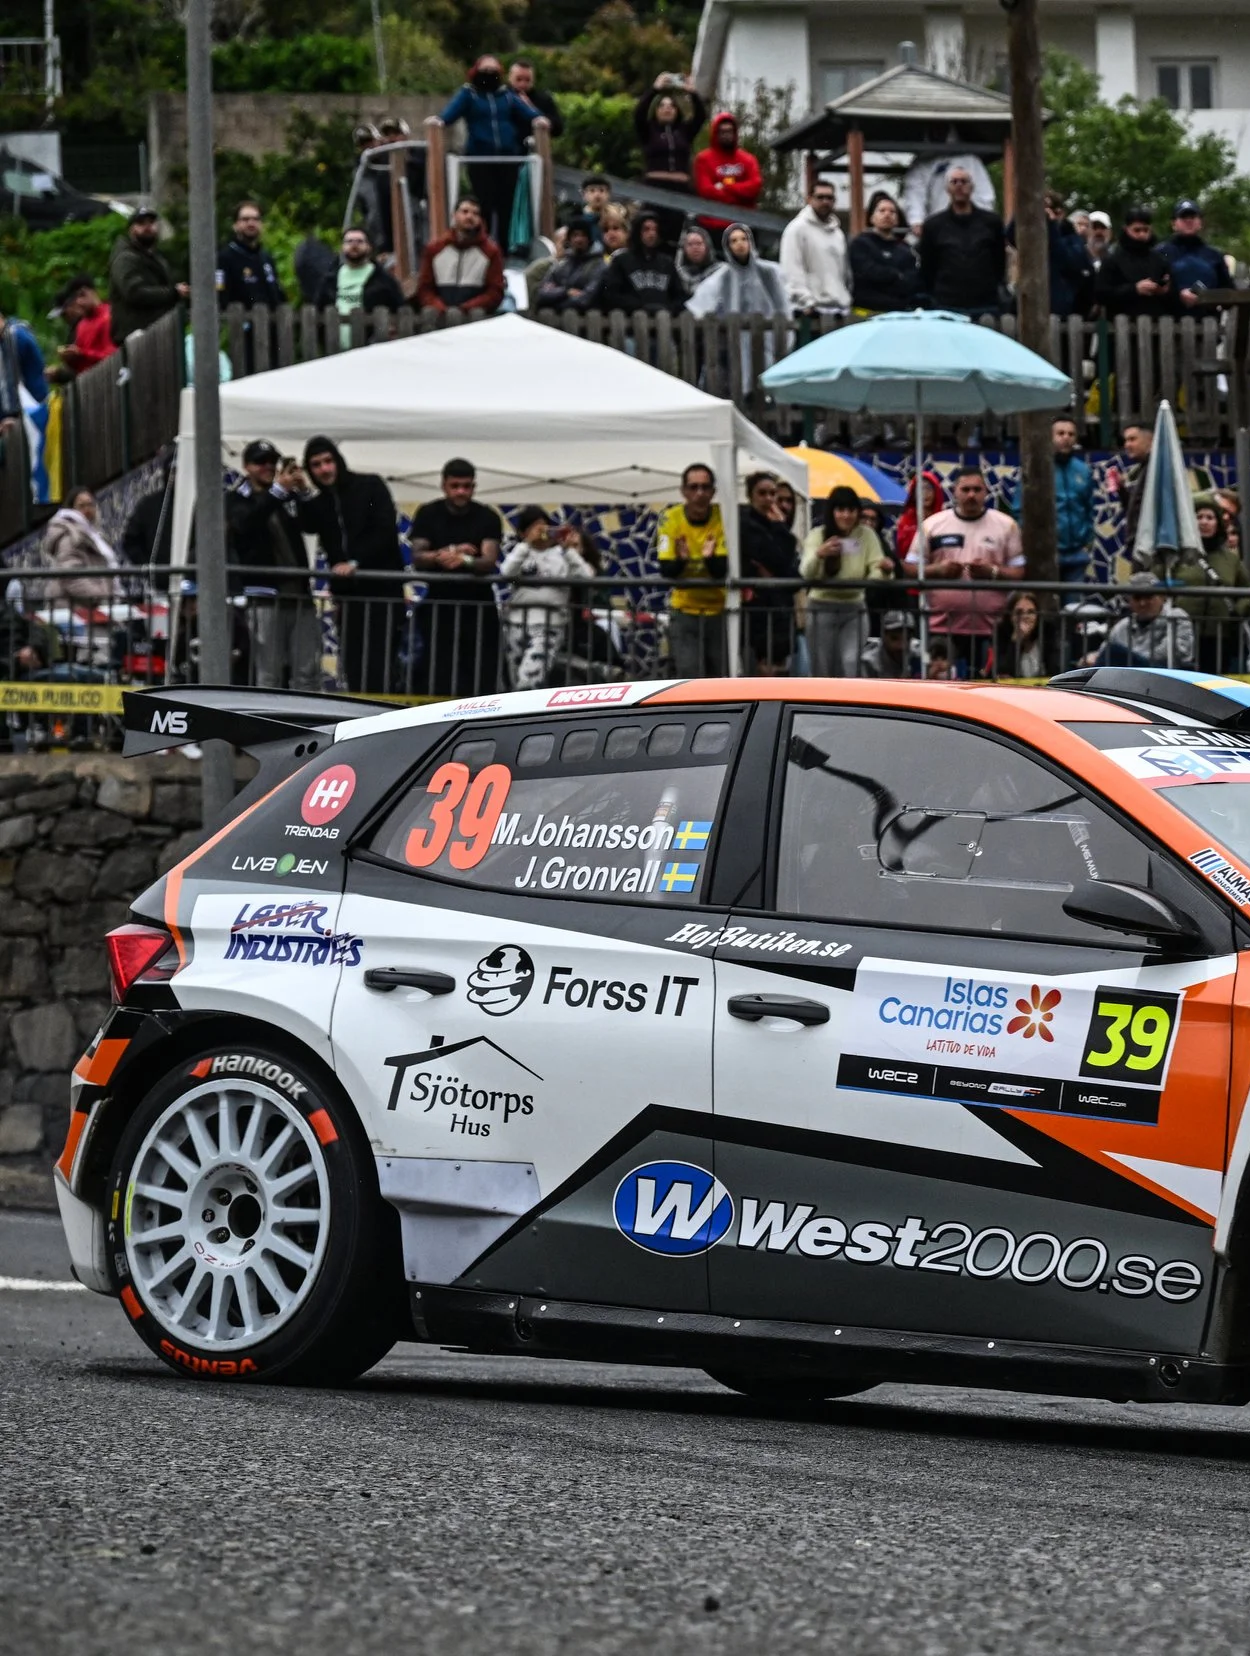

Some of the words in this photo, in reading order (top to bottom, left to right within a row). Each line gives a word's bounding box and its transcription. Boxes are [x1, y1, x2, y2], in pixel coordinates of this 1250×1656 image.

[2, 687, 38, 706] ZONA
[43, 688, 101, 707] PUBLICO
[442, 705, 503, 718] MOTORSPORT
[453, 698, 502, 712] MILLE
[552, 686, 626, 705] MOTUL
[150, 711, 189, 735] MS
[284, 825, 340, 840] TRENDAB
[405, 762, 512, 871] 39
[491, 812, 675, 851] M.Johansson
[515, 856, 662, 893] J.Gronvall
[1211, 874, 1246, 906] MANAGEMENT
[232, 902, 328, 935] LASER
[223, 933, 364, 967] INDUSTRIES
[664, 922, 853, 958] HojButiken.se
[543, 966, 648, 1013] Forss
[654, 975, 700, 1016] IT
[944, 976, 1009, 1009] Islas
[878, 996, 1003, 1036] Canarias
[926, 1039, 962, 1055] LATITUD
[963, 1044, 976, 1056] DE
[977, 1044, 997, 1058] VIDA
[1086, 1001, 1172, 1071] 39
[868, 1067, 919, 1084] WRC2
[949, 1080, 988, 1090] BEYOND
[410, 1072, 534, 1123] Sjötorps
[450, 1113, 491, 1137] Hus
[633, 1178, 728, 1240] W
[736, 1197, 1203, 1301] West2000.se
